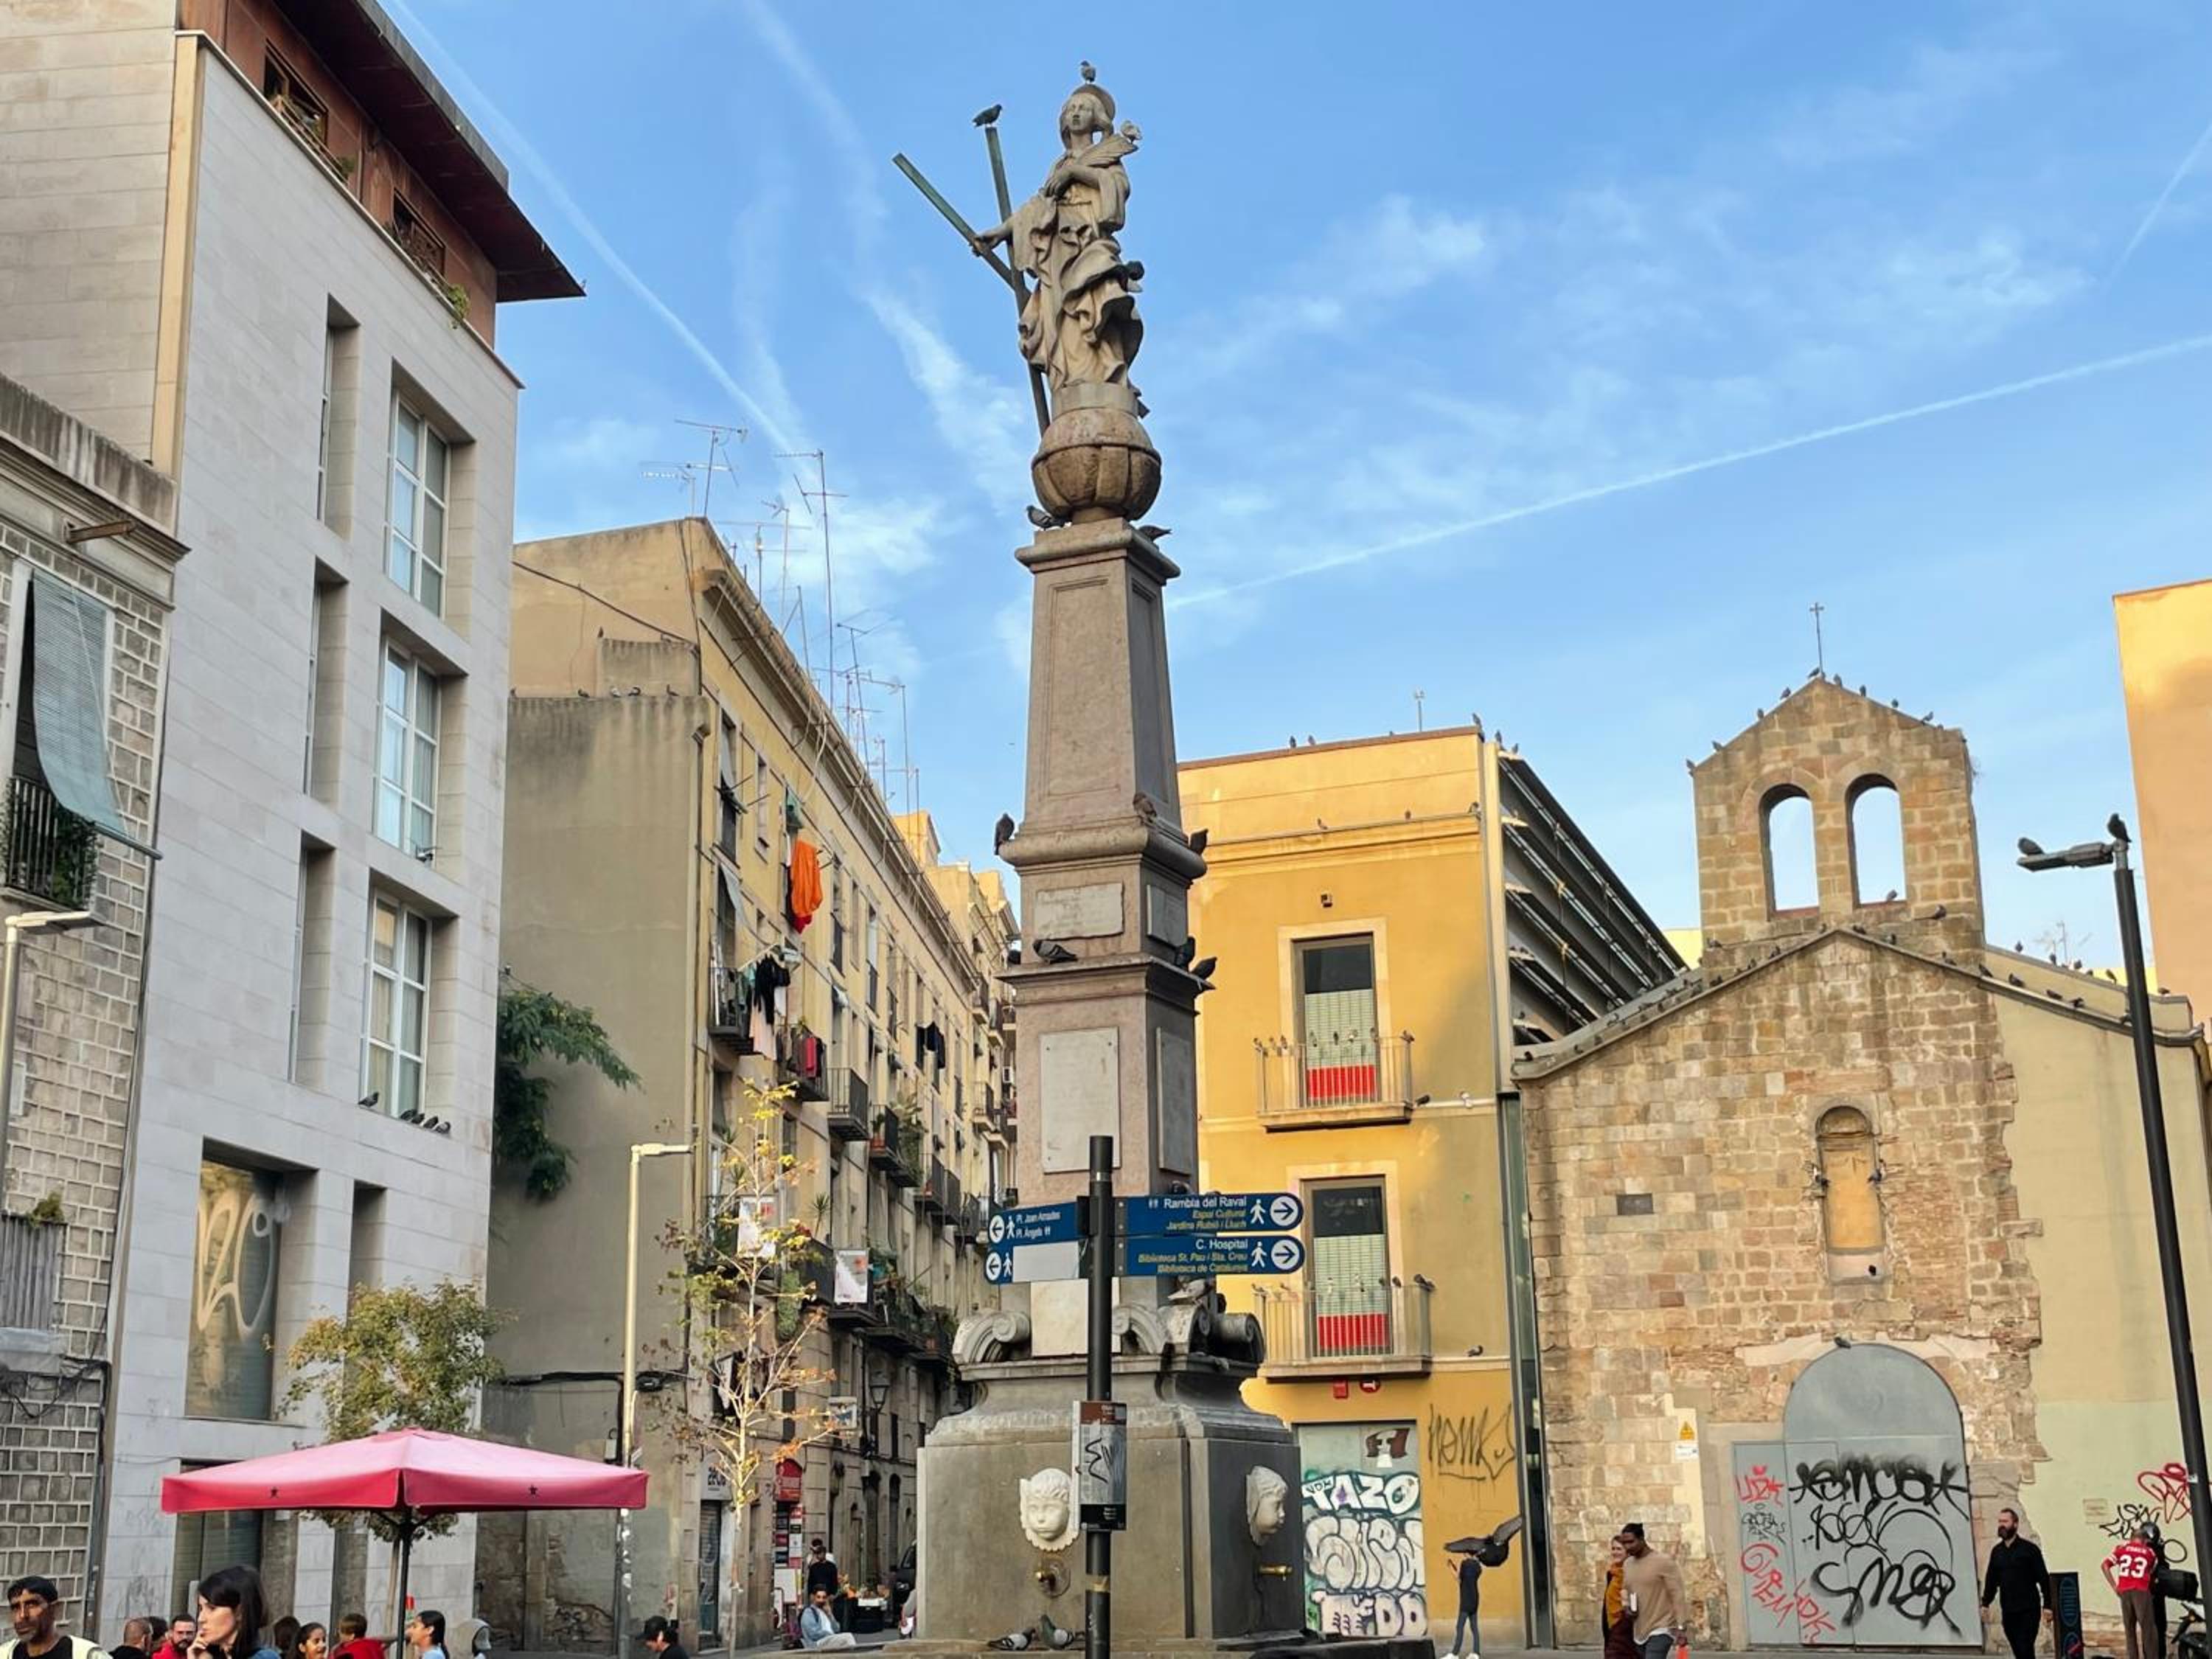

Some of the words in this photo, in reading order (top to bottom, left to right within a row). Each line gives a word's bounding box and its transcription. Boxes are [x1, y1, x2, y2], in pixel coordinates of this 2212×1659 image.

[1164, 1197, 1200, 1208] Rambla
[1202, 1197, 1217, 1208] del
[1219, 1196, 1247, 1207] Raval
[1195, 1239, 1207, 1250] C.
[1208, 1239, 1248, 1251] Hospital
[2119, 1554, 2148, 1579] 23
